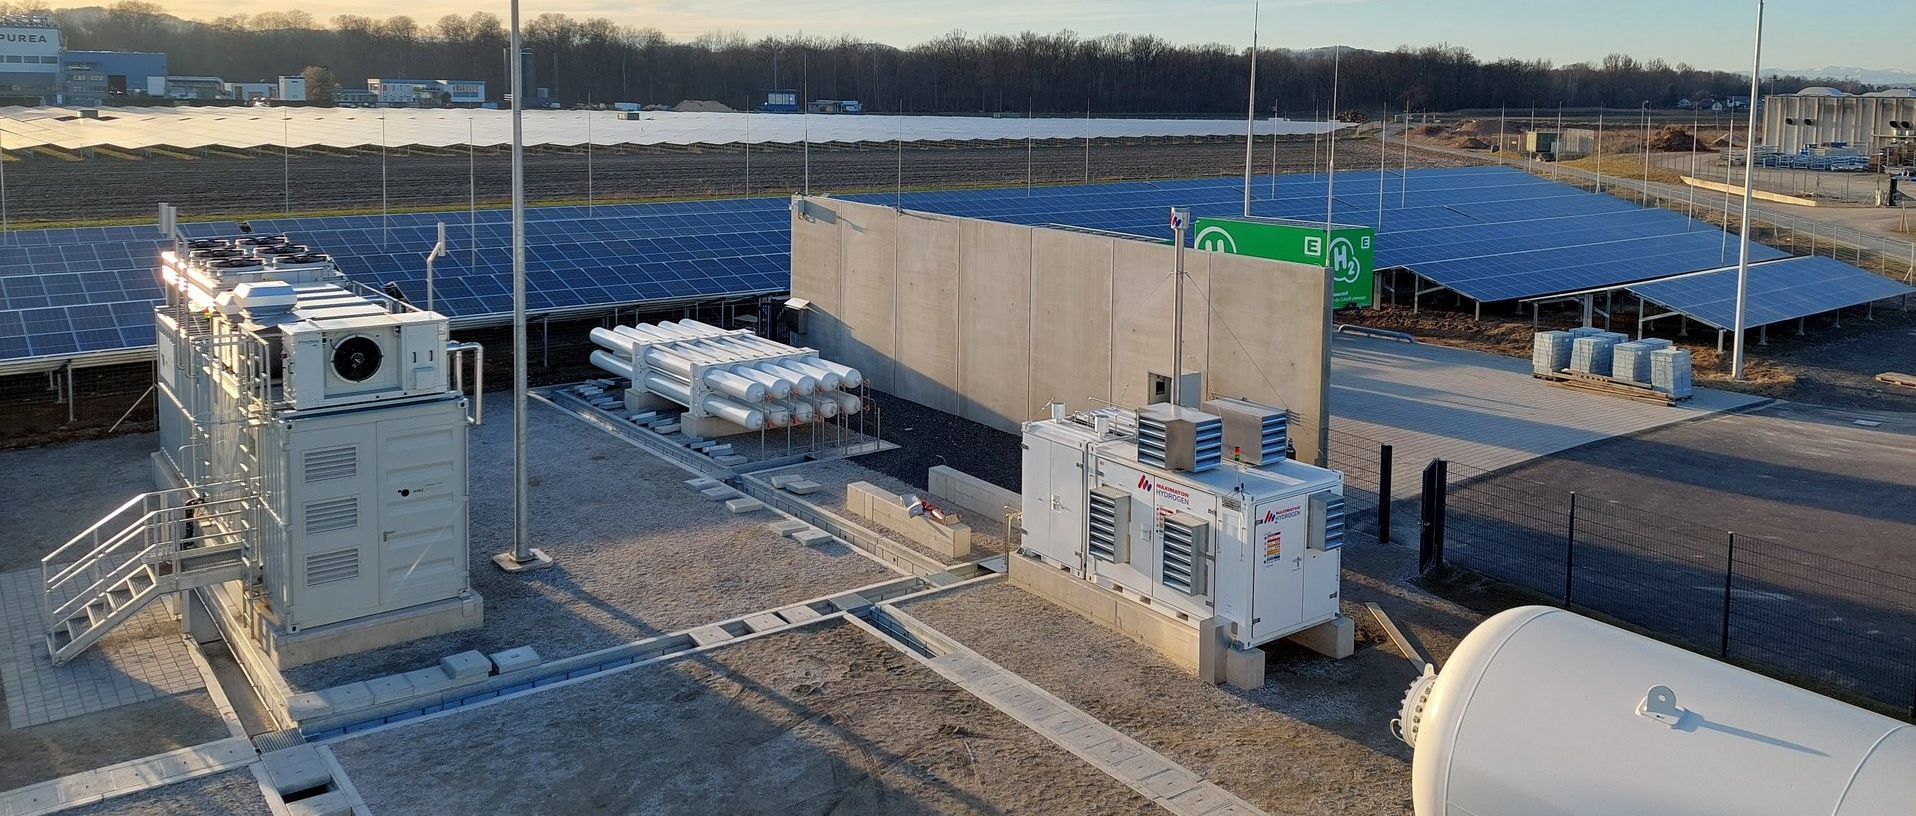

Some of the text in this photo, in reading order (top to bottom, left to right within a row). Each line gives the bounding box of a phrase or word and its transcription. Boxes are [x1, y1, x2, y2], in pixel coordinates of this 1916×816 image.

[1306, 238, 1319, 254] E
[1156, 483, 1190, 498] MAXIMATOR
[1156, 490, 1190, 505] HYDROGEN
[1275, 505, 1301, 515] MAXIMATOR
[1275, 510, 1301, 521] HYDROGEN
